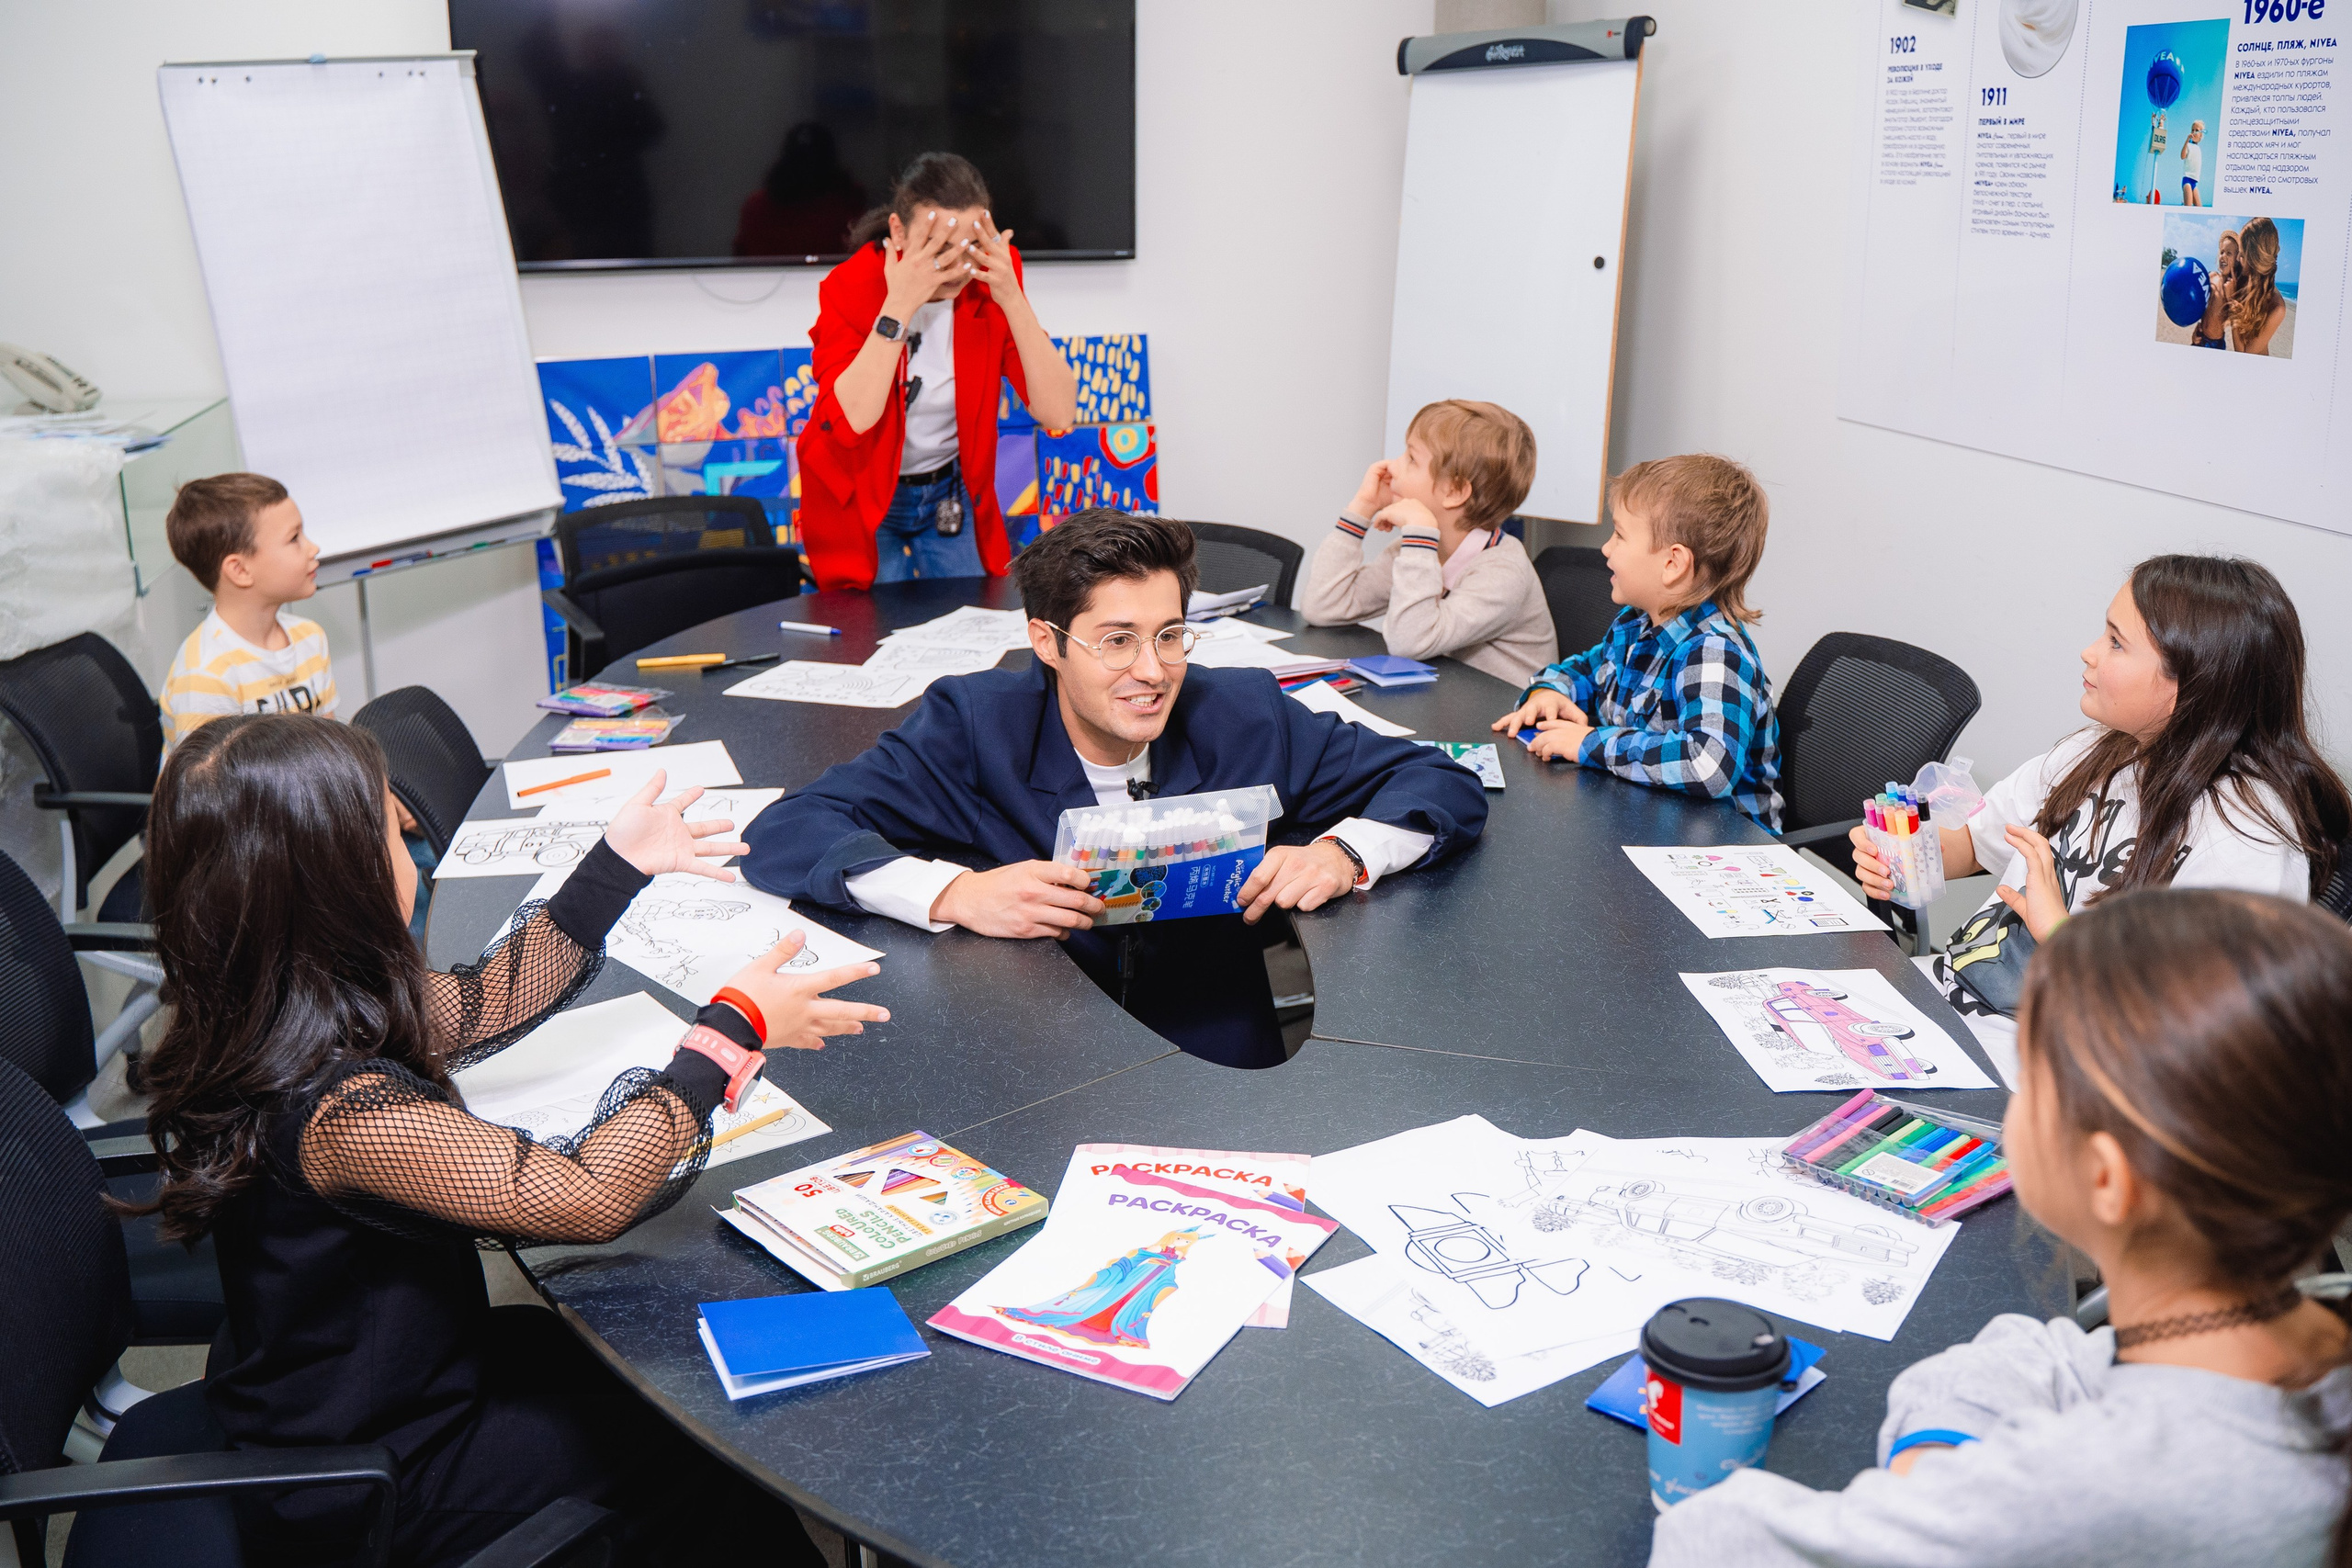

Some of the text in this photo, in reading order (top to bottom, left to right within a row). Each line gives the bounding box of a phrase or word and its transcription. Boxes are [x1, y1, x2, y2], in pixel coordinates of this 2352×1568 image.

[2244, 0, 2325, 25] 1960-е
[1890, 36, 1917, 54] 1902
[2237, 38, 2337, 52] СОЛНЦЕ, ПЛЯЖ, NIVEA
[2235, 60, 2240, 69] В
[2242, 59, 2267, 68] 1960-ых
[2274, 58, 2300, 66] 1970-ых
[2301, 57, 2334, 67] фургоны
[2233, 69, 2328, 80] NIVEA ездили по пляжам
[2233, 81, 2332, 92] международных курортов,
[1982, 87, 2007, 106] 1911
[2232, 92, 2323, 104] привлекая толпы людей.
[2231, 106, 2261, 115] Каждый,
[2277, 105, 2326, 114] пользовался
[1978, 116, 2002, 126] ПЕРВЫЙ
[2229, 118, 2300, 127] солнцезащитными
[2228, 129, 2332, 139] средствами NIVEA, получал
[2226, 152, 2316, 161] наслаждаться пляжным
[2225, 164, 2309, 173] отдыхом под надзором
[2224, 175, 2267, 183] спасателей
[2278, 176, 2319, 185] смотровых
[2223, 186, 2273, 195] вышек NIVEA.
[1230, 859, 1244, 887] Acrylic
[1182, 865, 1201, 908] 丙烯马克笔
[1223, 879, 1234, 903] Marker
[794, 1183, 823, 1198] 50
[808, 1175, 842, 1194] ЦВЕТОВ
[854, 1193, 893, 1219] КАРАНДАШИ
[984, 1183, 1011, 1215] HIGH CLASS LEAD
[888, 1205, 932, 1235] ТРЕХГРАННЫЕ
[893, 1216, 923, 1237] ЦВЕТНЫЕ
[1108, 1193, 1282, 1248] РАСКРАСКА
[821, 1228, 856, 1257] BRAUBERG
[869, 1262, 900, 1279] BRAUBERG
